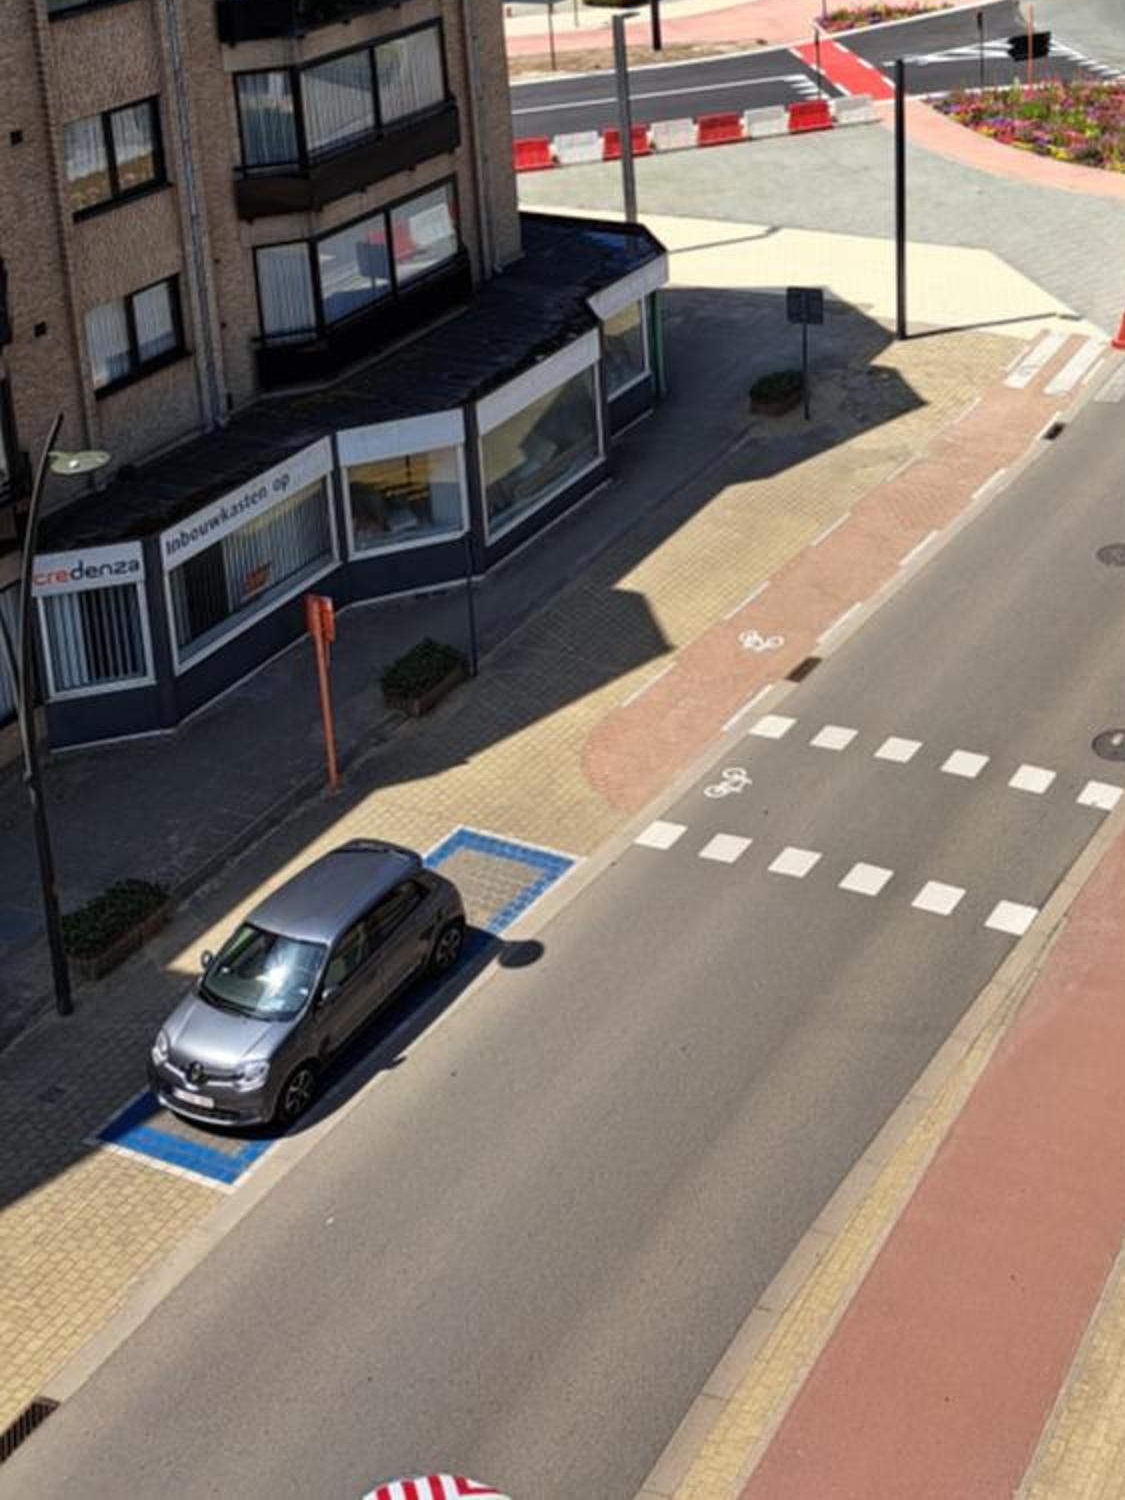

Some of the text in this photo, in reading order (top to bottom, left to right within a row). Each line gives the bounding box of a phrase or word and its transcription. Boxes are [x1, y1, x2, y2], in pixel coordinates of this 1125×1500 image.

[165, 473, 290, 556] Inbouwkasten op
[32, 559, 140, 586] credenza
